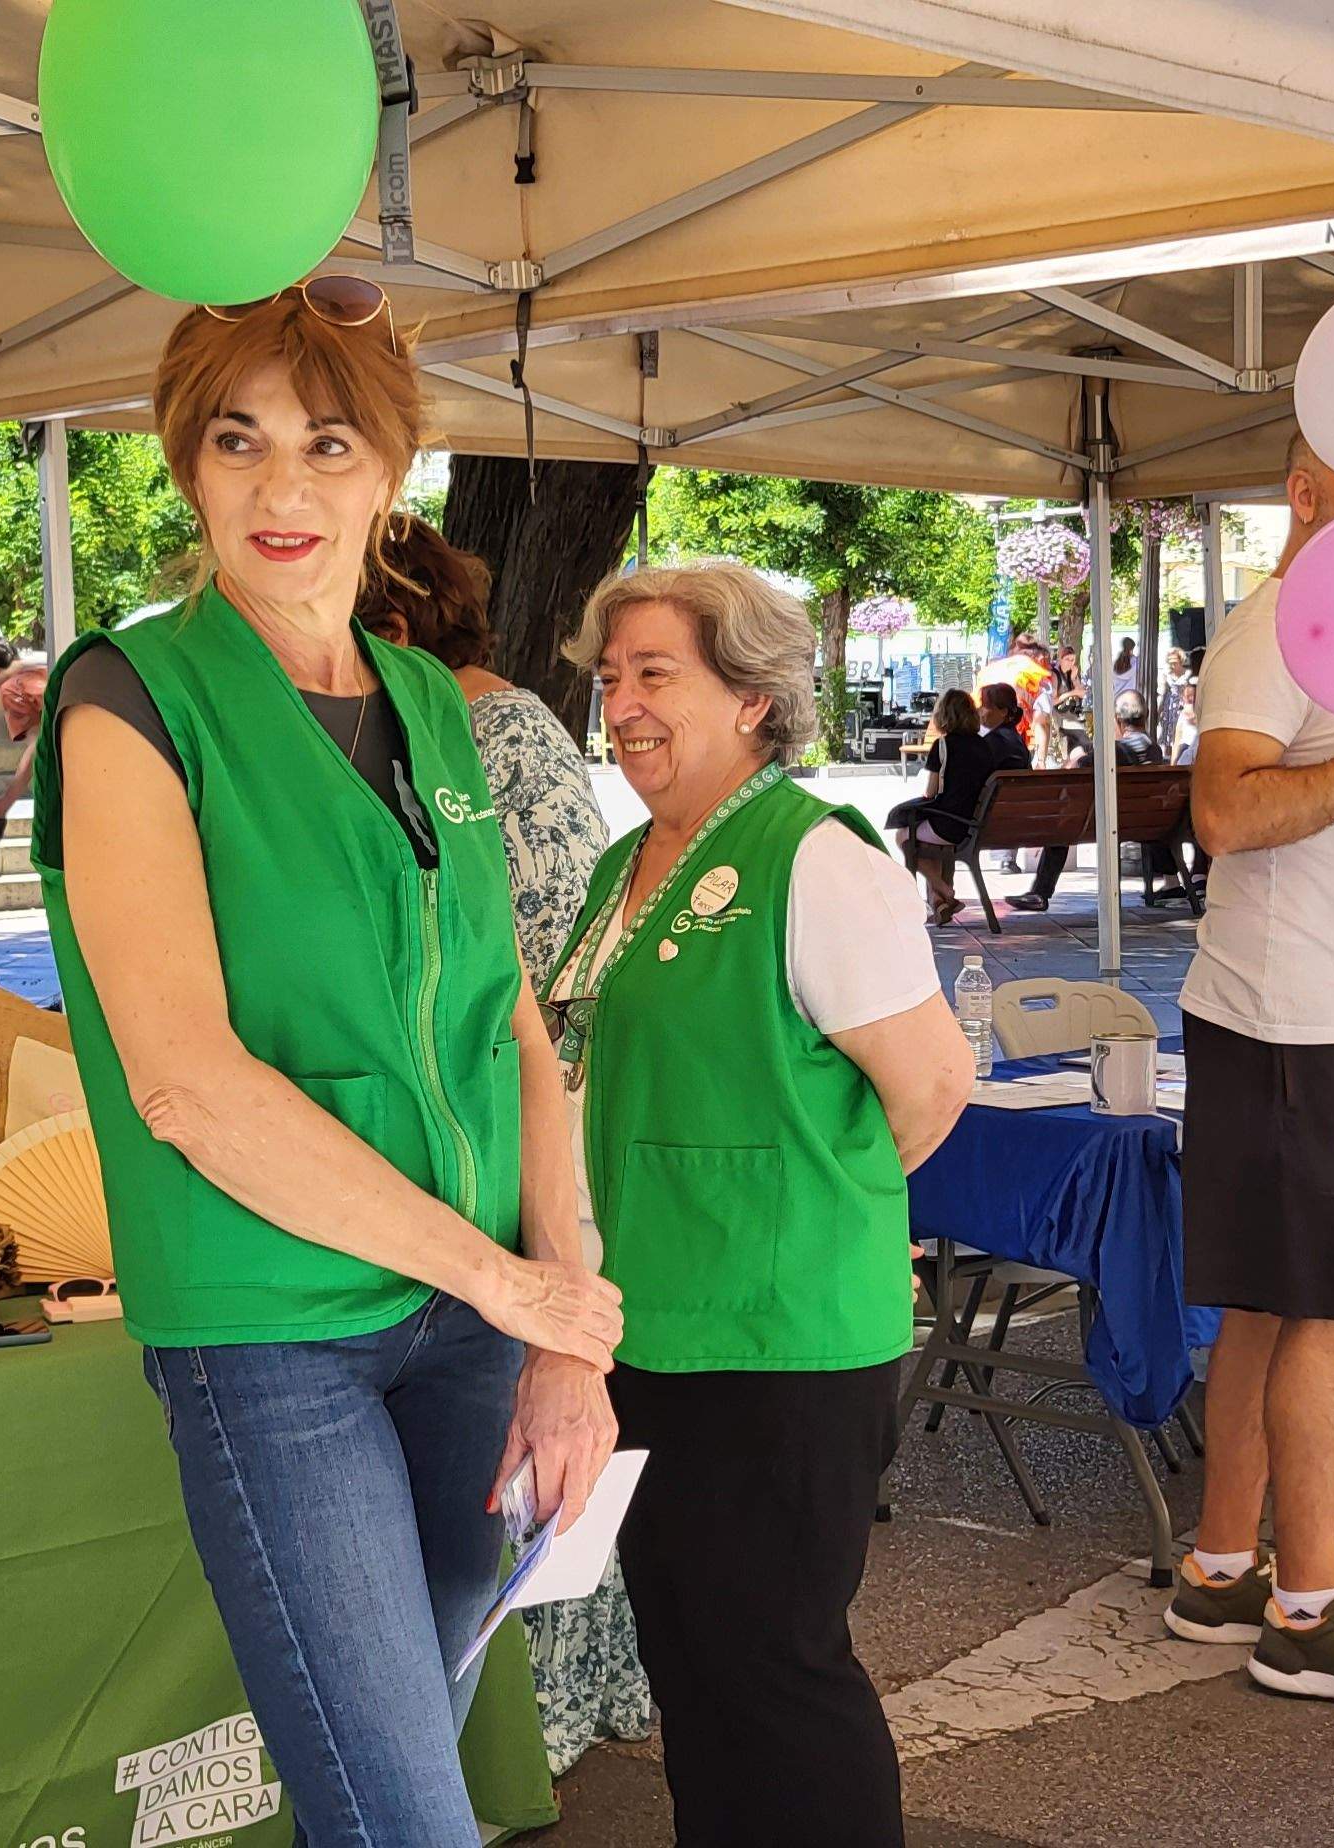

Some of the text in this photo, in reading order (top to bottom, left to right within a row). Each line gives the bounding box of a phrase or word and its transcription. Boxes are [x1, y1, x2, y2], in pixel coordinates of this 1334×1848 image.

[707, 871, 736, 895] PILAR
[148, 1716, 259, 1777] CONTIG
[144, 1755, 253, 1812] DAMOS
[139, 1788, 275, 1845] LA CARA
